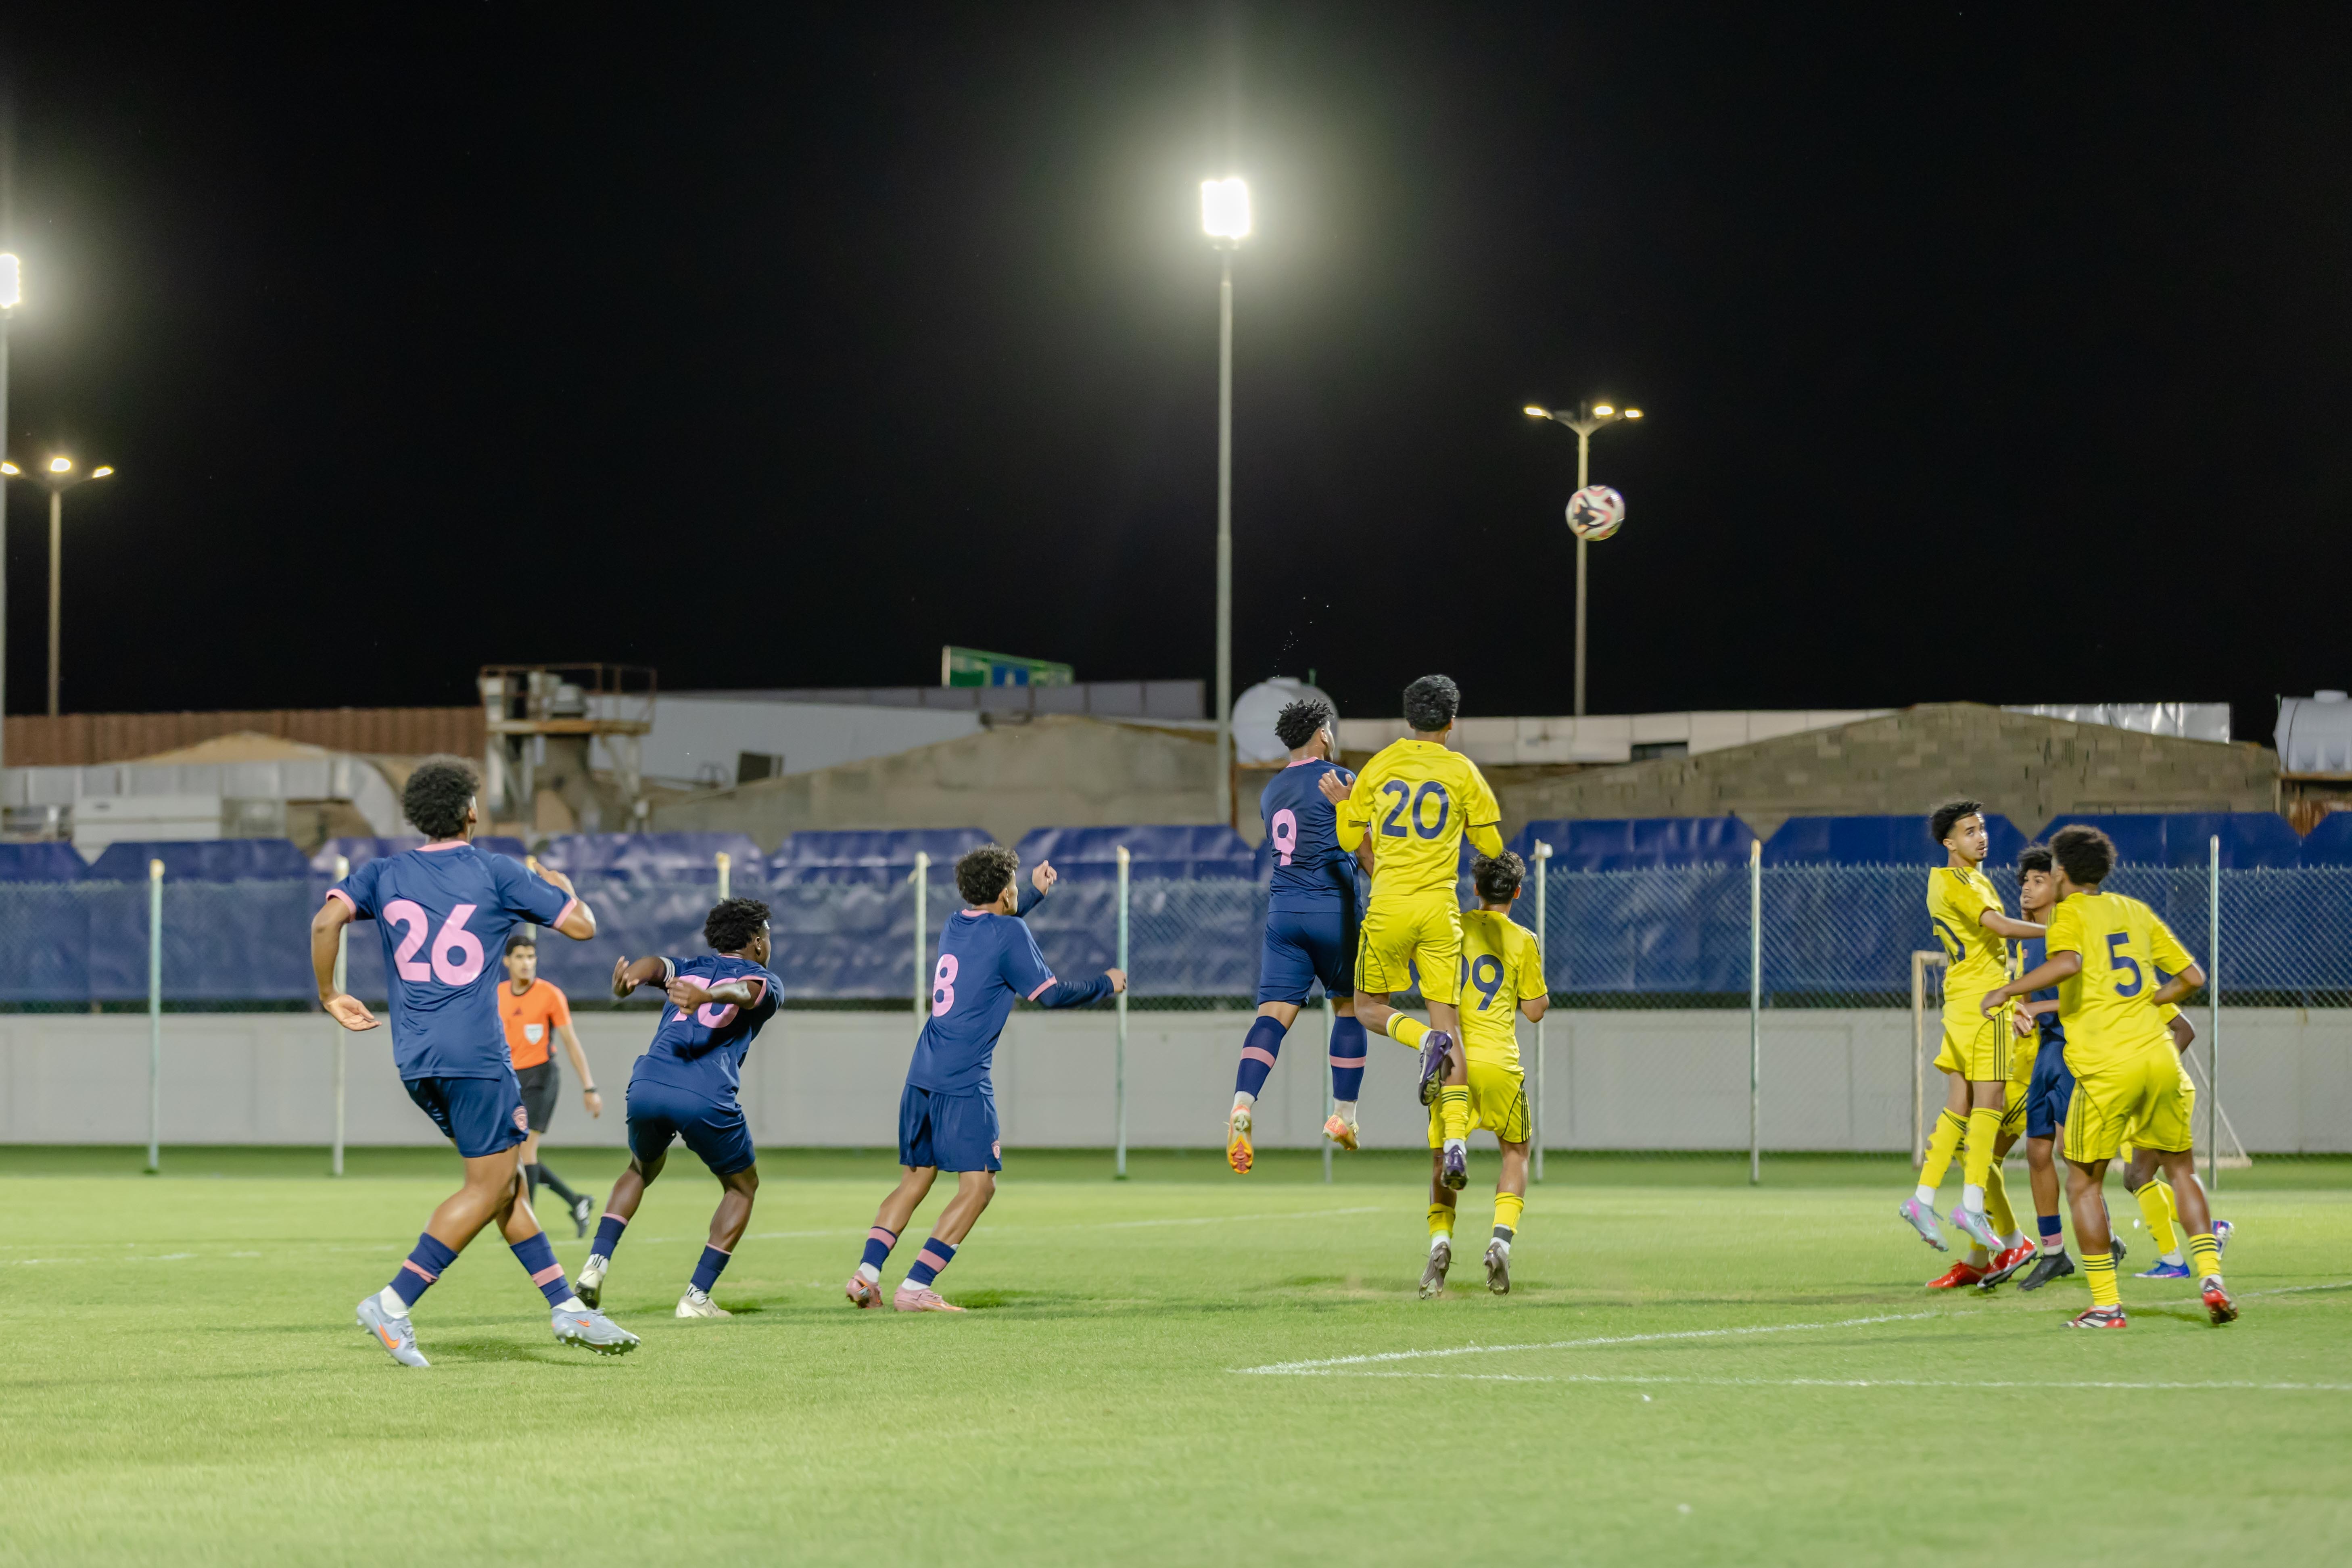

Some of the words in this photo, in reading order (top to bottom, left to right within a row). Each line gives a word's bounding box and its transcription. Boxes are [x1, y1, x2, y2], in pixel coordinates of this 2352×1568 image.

[1272, 808, 1297, 866] 9
[1381, 779, 1449, 839] 20
[382, 899, 485, 986] 26
[2106, 932, 2143, 997] 5
[932, 953, 959, 1017] 8
[1461, 953, 1504, 1011] 9
